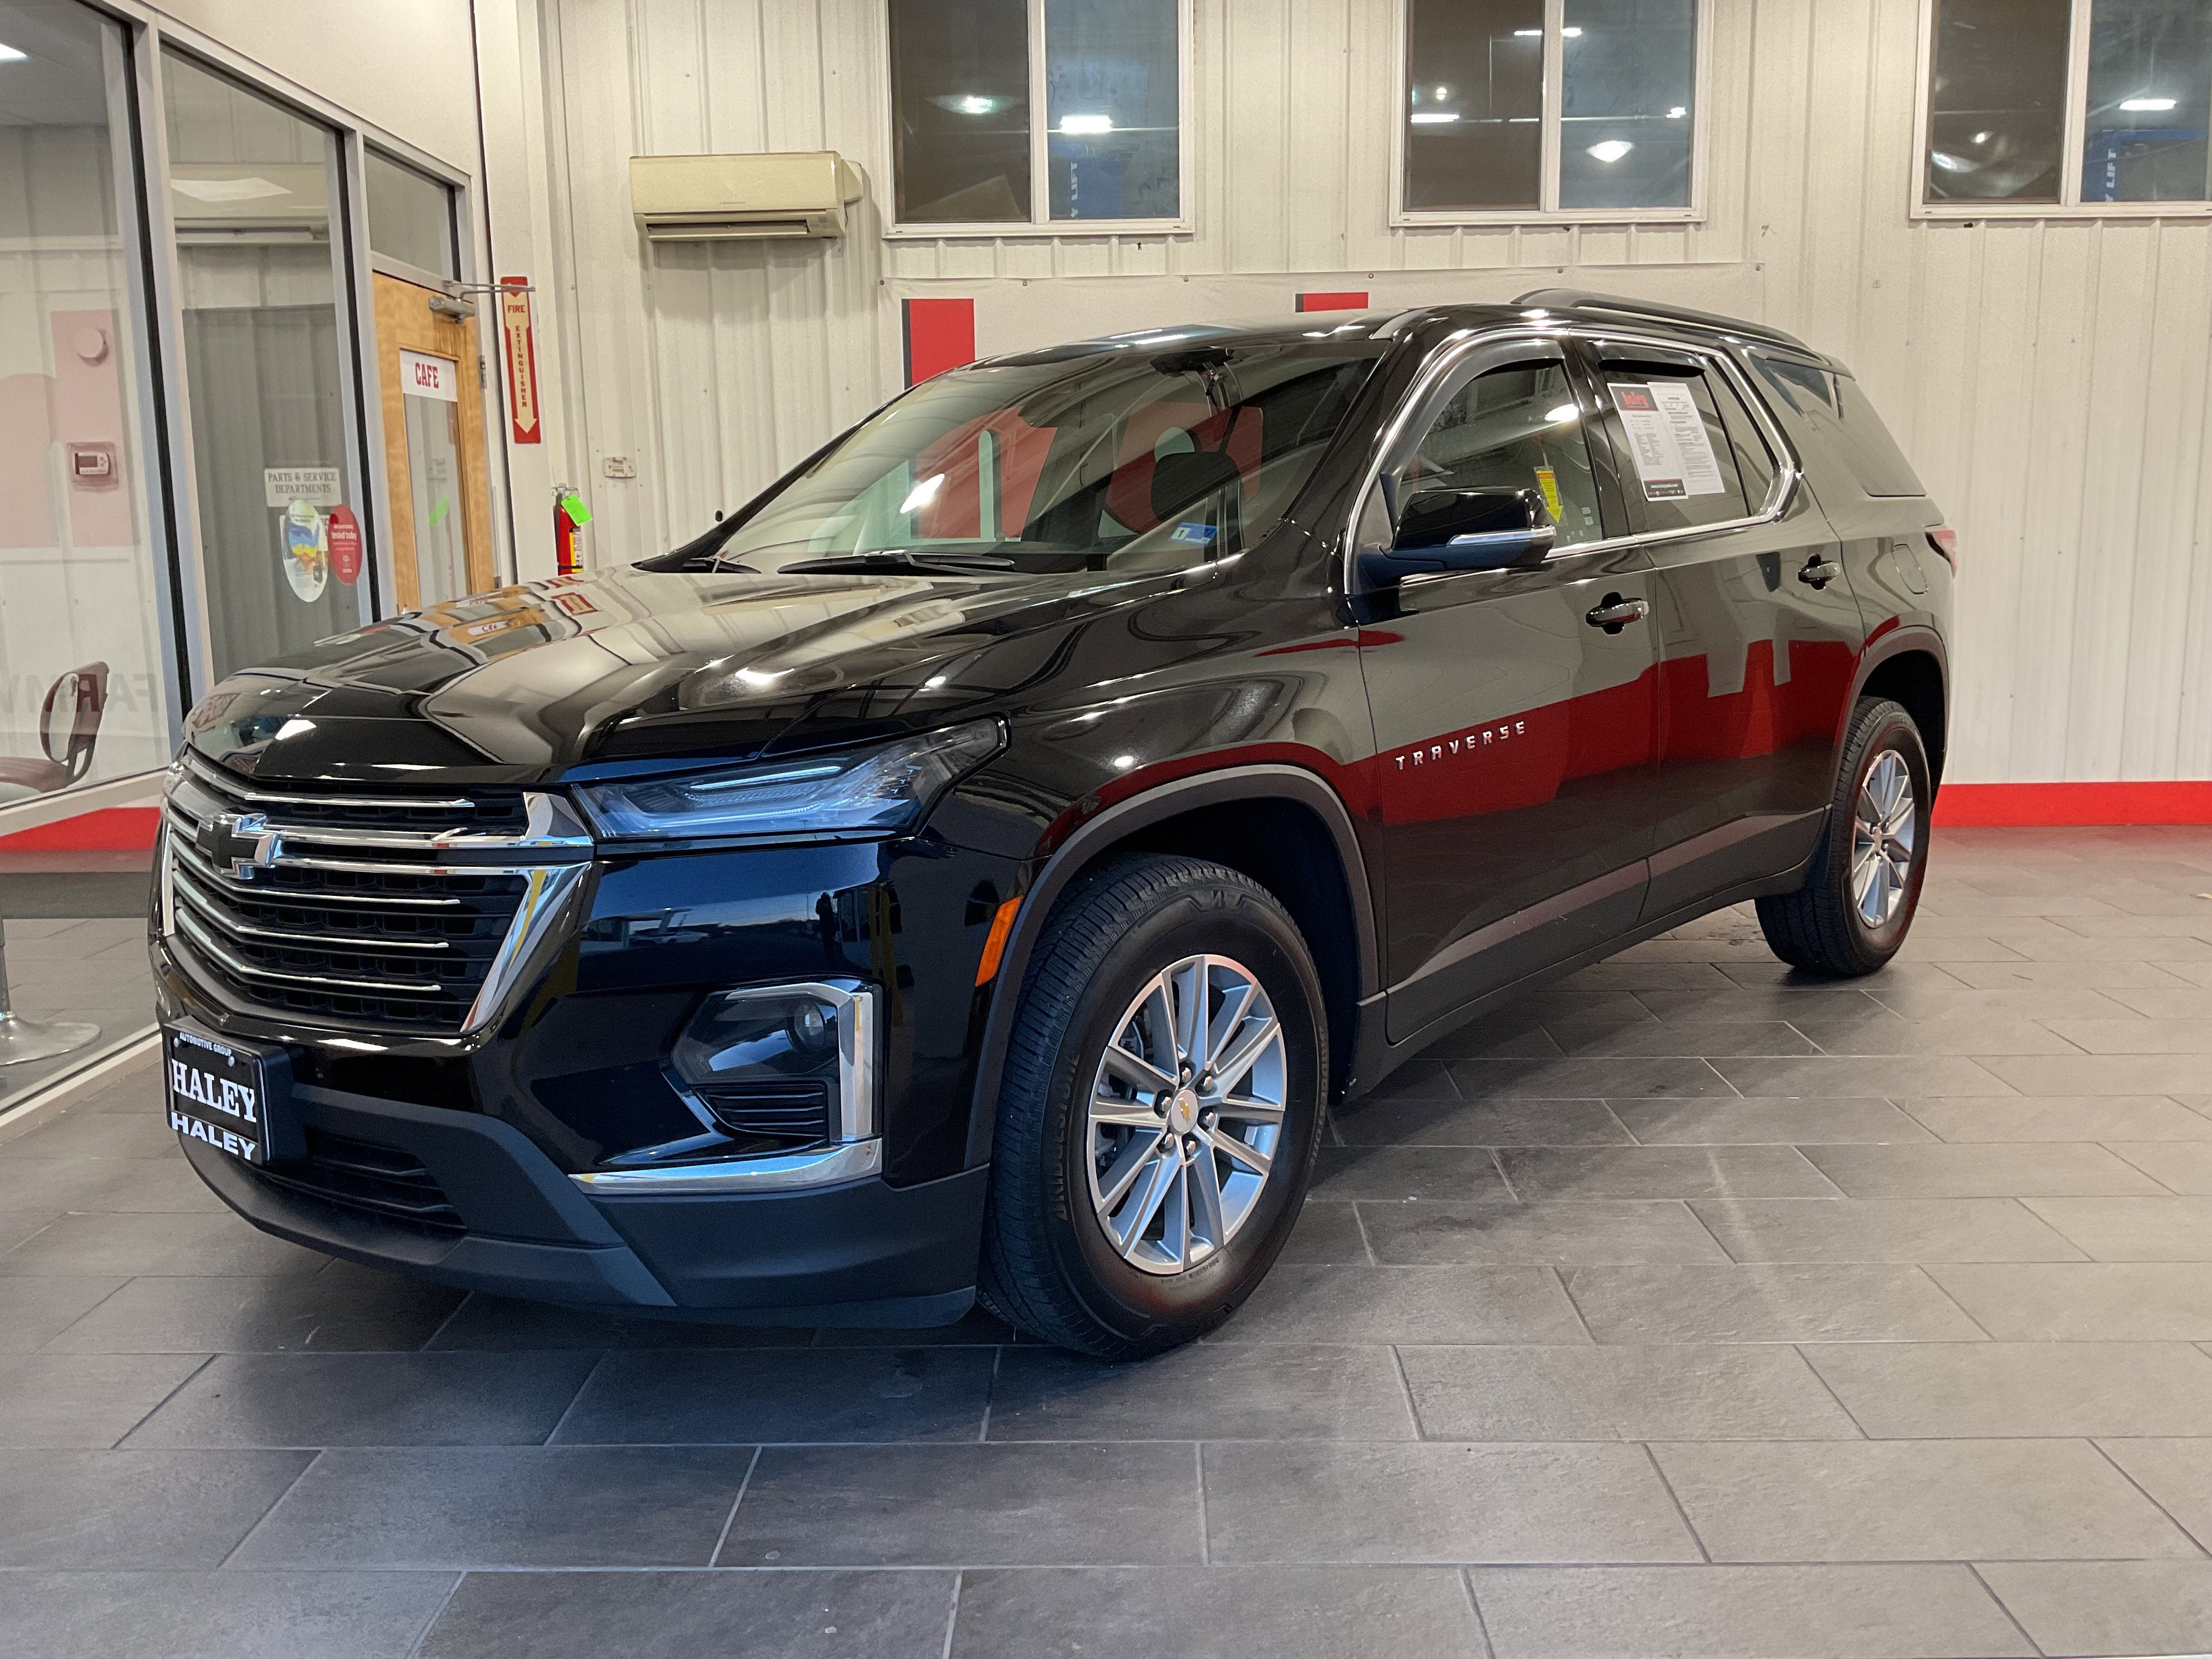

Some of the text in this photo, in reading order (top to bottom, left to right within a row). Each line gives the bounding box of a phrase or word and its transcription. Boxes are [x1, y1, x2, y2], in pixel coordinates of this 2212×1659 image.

[2106, 149, 2117, 188] LIFT
[507, 304, 526, 314] FIRE
[415, 362, 439, 389] CAFE
[516, 325, 527, 408] EXTINGUISHER
[268, 472, 337, 482] PARTS & SERVICE
[275, 484, 331, 494] DEPARTMENTS
[1395, 721, 1525, 770] TRAVERSE
[179, 1031, 233, 1057] AUTOMOTIVE GROUP
[171, 1058, 257, 1123] HALEY
[171, 1111, 256, 1161] HALEY
